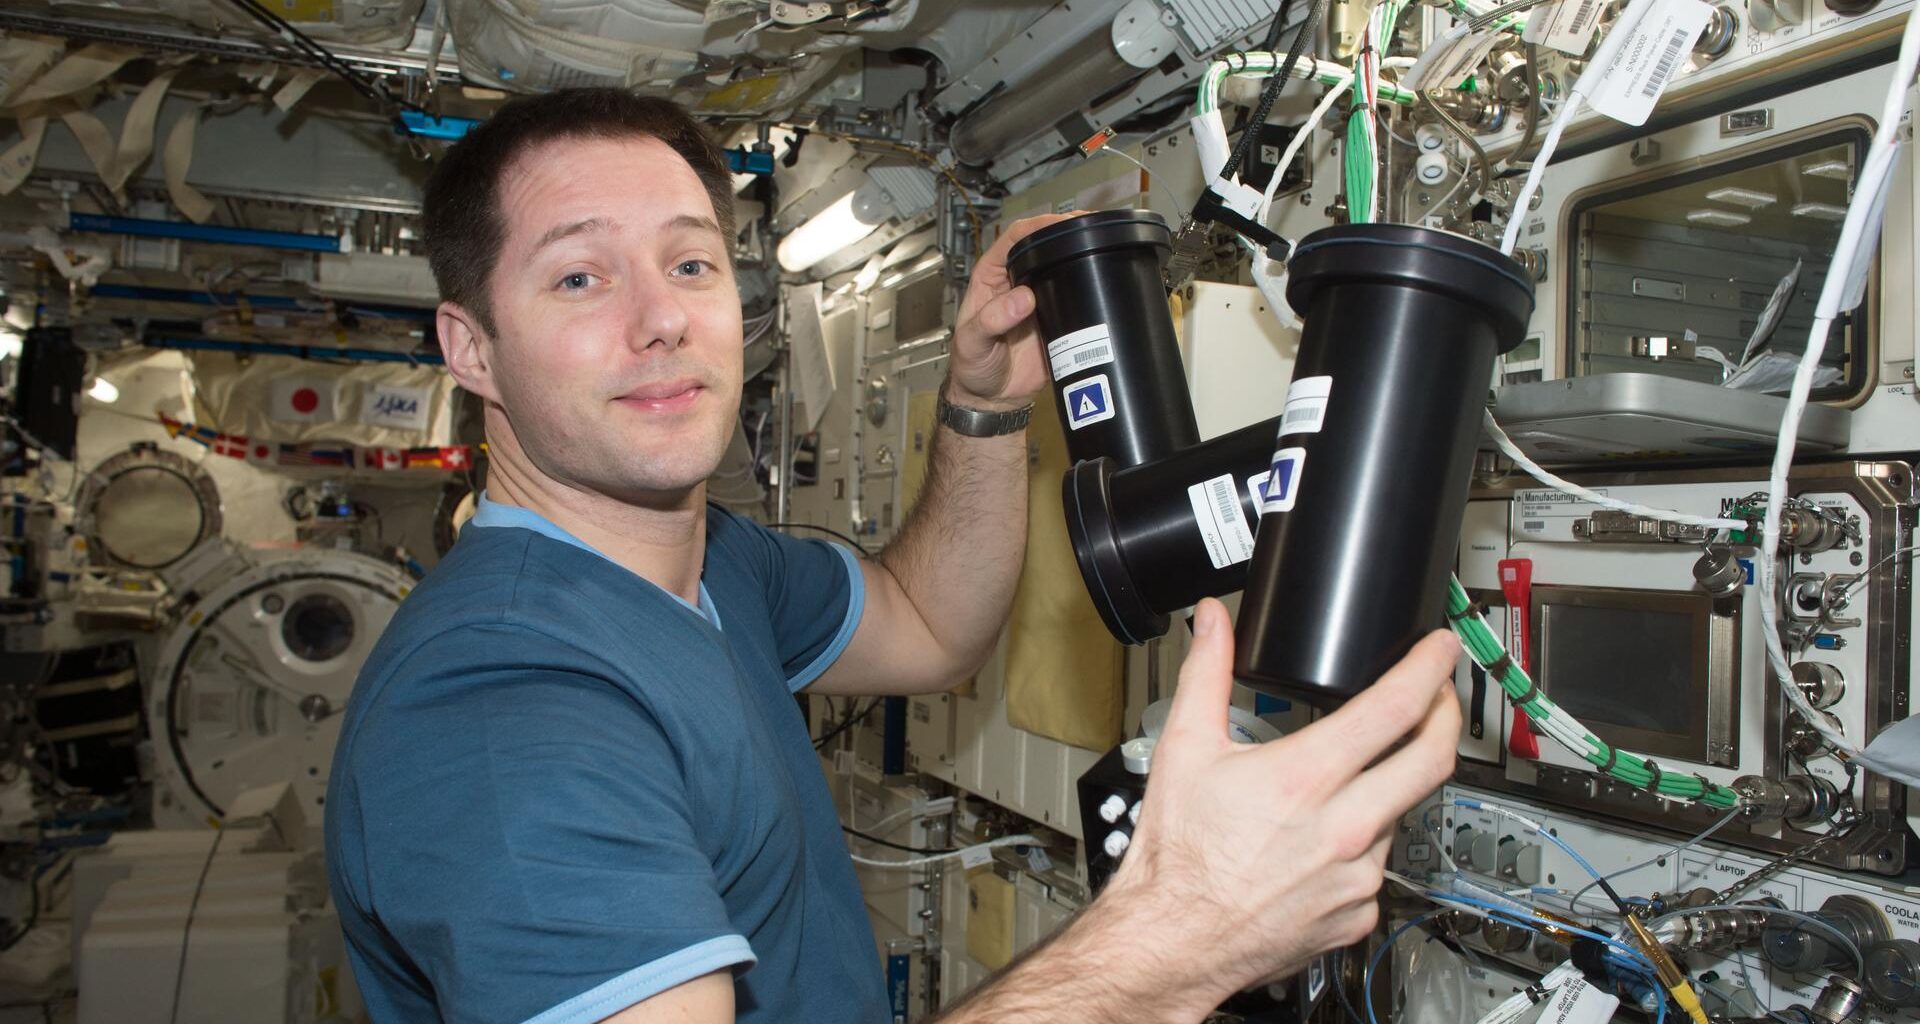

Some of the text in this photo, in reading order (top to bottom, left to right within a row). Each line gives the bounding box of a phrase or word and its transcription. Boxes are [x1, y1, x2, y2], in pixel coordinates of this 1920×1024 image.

[1083, 400, 1089, 411] 1
[1525, 491, 1576, 504] Manufacturing
[1715, 863, 1746, 877] LAPTOP
[1759, 888, 1773, 897] DATA
[1884, 904, 1920, 921] COOLA
[1897, 918, 1920, 929] WATER
[1557, 994, 1569, 1010] LAPTOP
